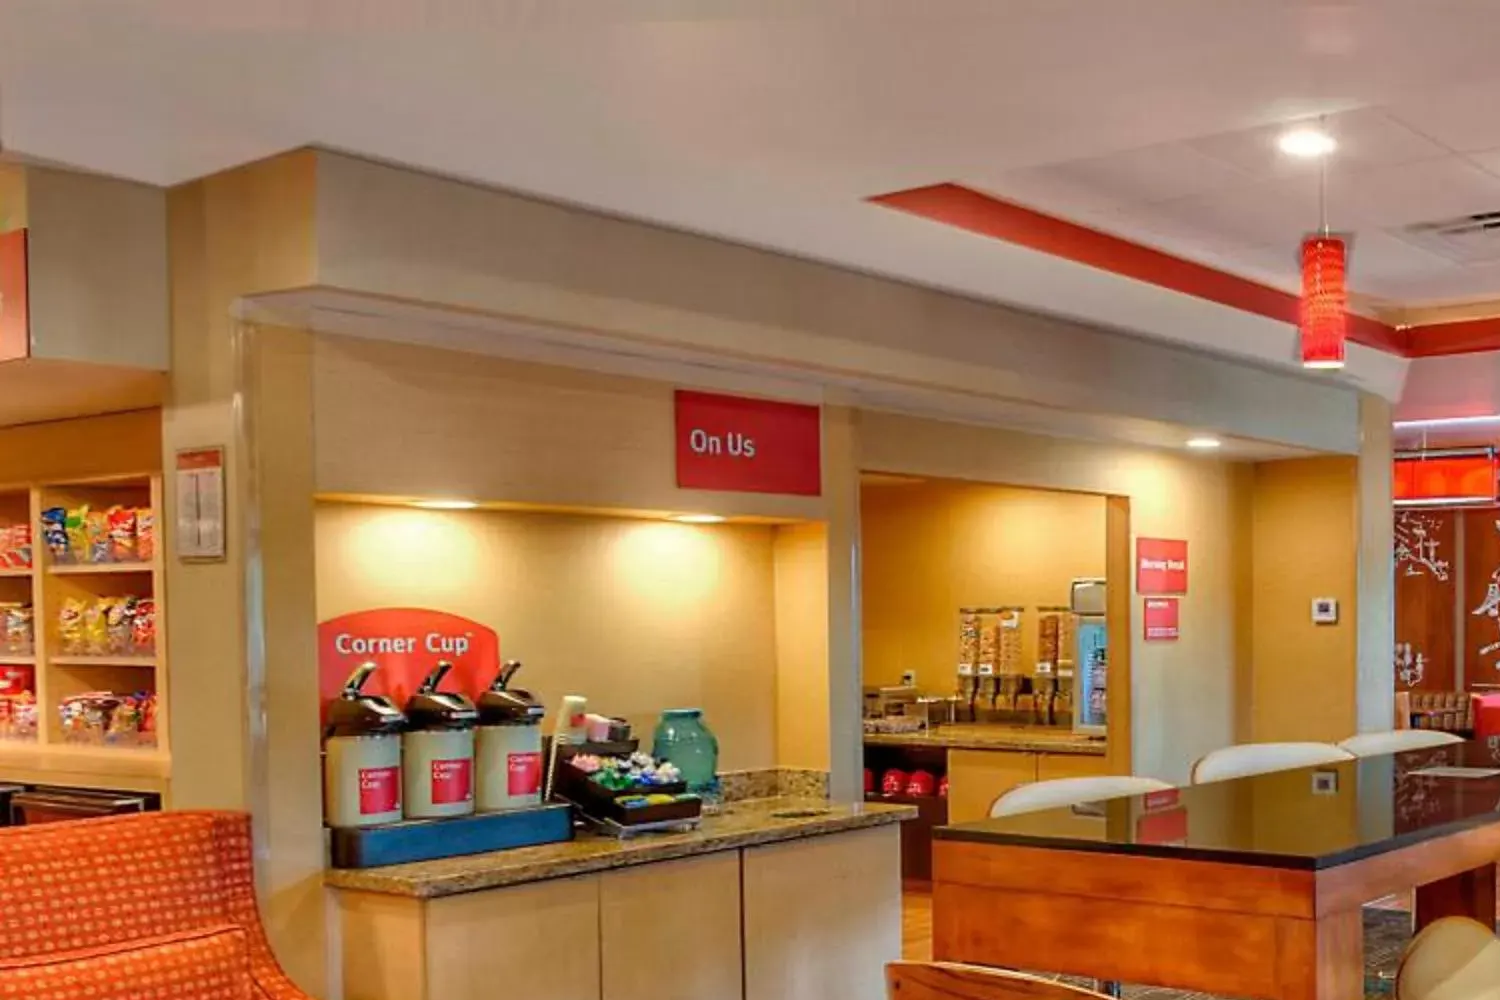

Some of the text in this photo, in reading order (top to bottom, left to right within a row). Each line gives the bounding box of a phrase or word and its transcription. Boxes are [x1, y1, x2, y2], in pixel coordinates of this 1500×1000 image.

[690, 428, 756, 458] On Us
[335, 632, 469, 656] Corner Cup
